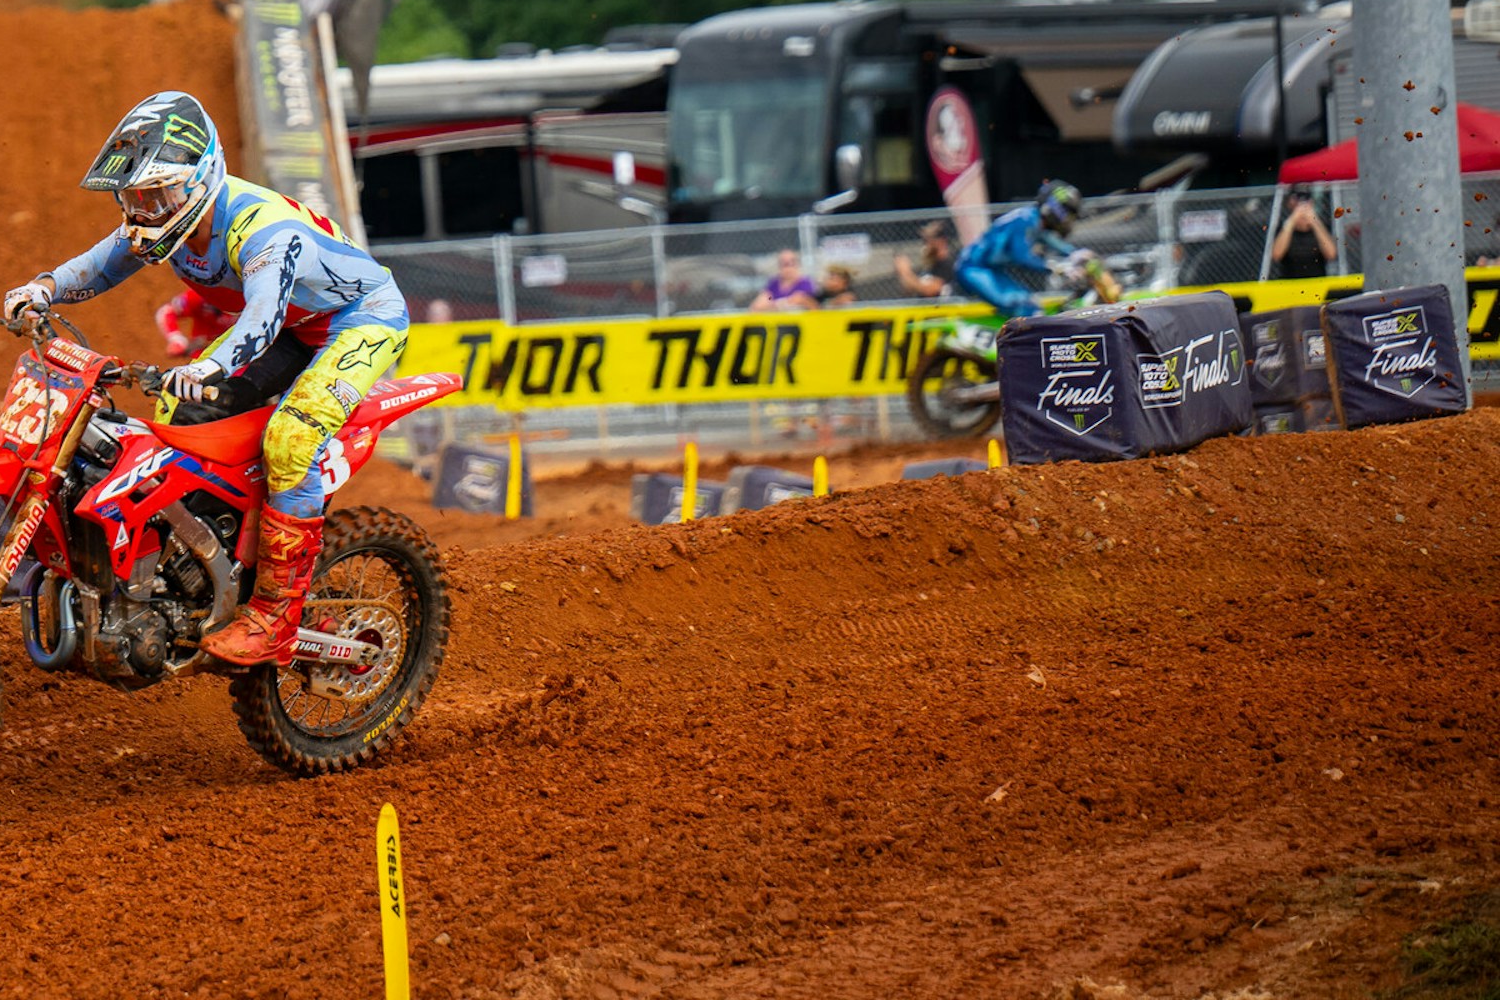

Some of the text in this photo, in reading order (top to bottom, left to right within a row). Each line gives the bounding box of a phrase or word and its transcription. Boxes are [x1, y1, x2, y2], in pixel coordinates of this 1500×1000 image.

[647, 325, 801, 390] THOR
[1182, 331, 1230, 402] Finals
[1365, 336, 1438, 382] Finals
[0, 377, 69, 444] 23
[380, 386, 438, 410] DUNLOP
[1037, 369, 1115, 411] Finals
[94, 446, 175, 504] CRF
[5, 503, 46, 577] SHOWA
[329, 645, 353, 659] DID
[363, 696, 409, 744] DUNLOP
[386, 833, 401, 919] ACERBIS
